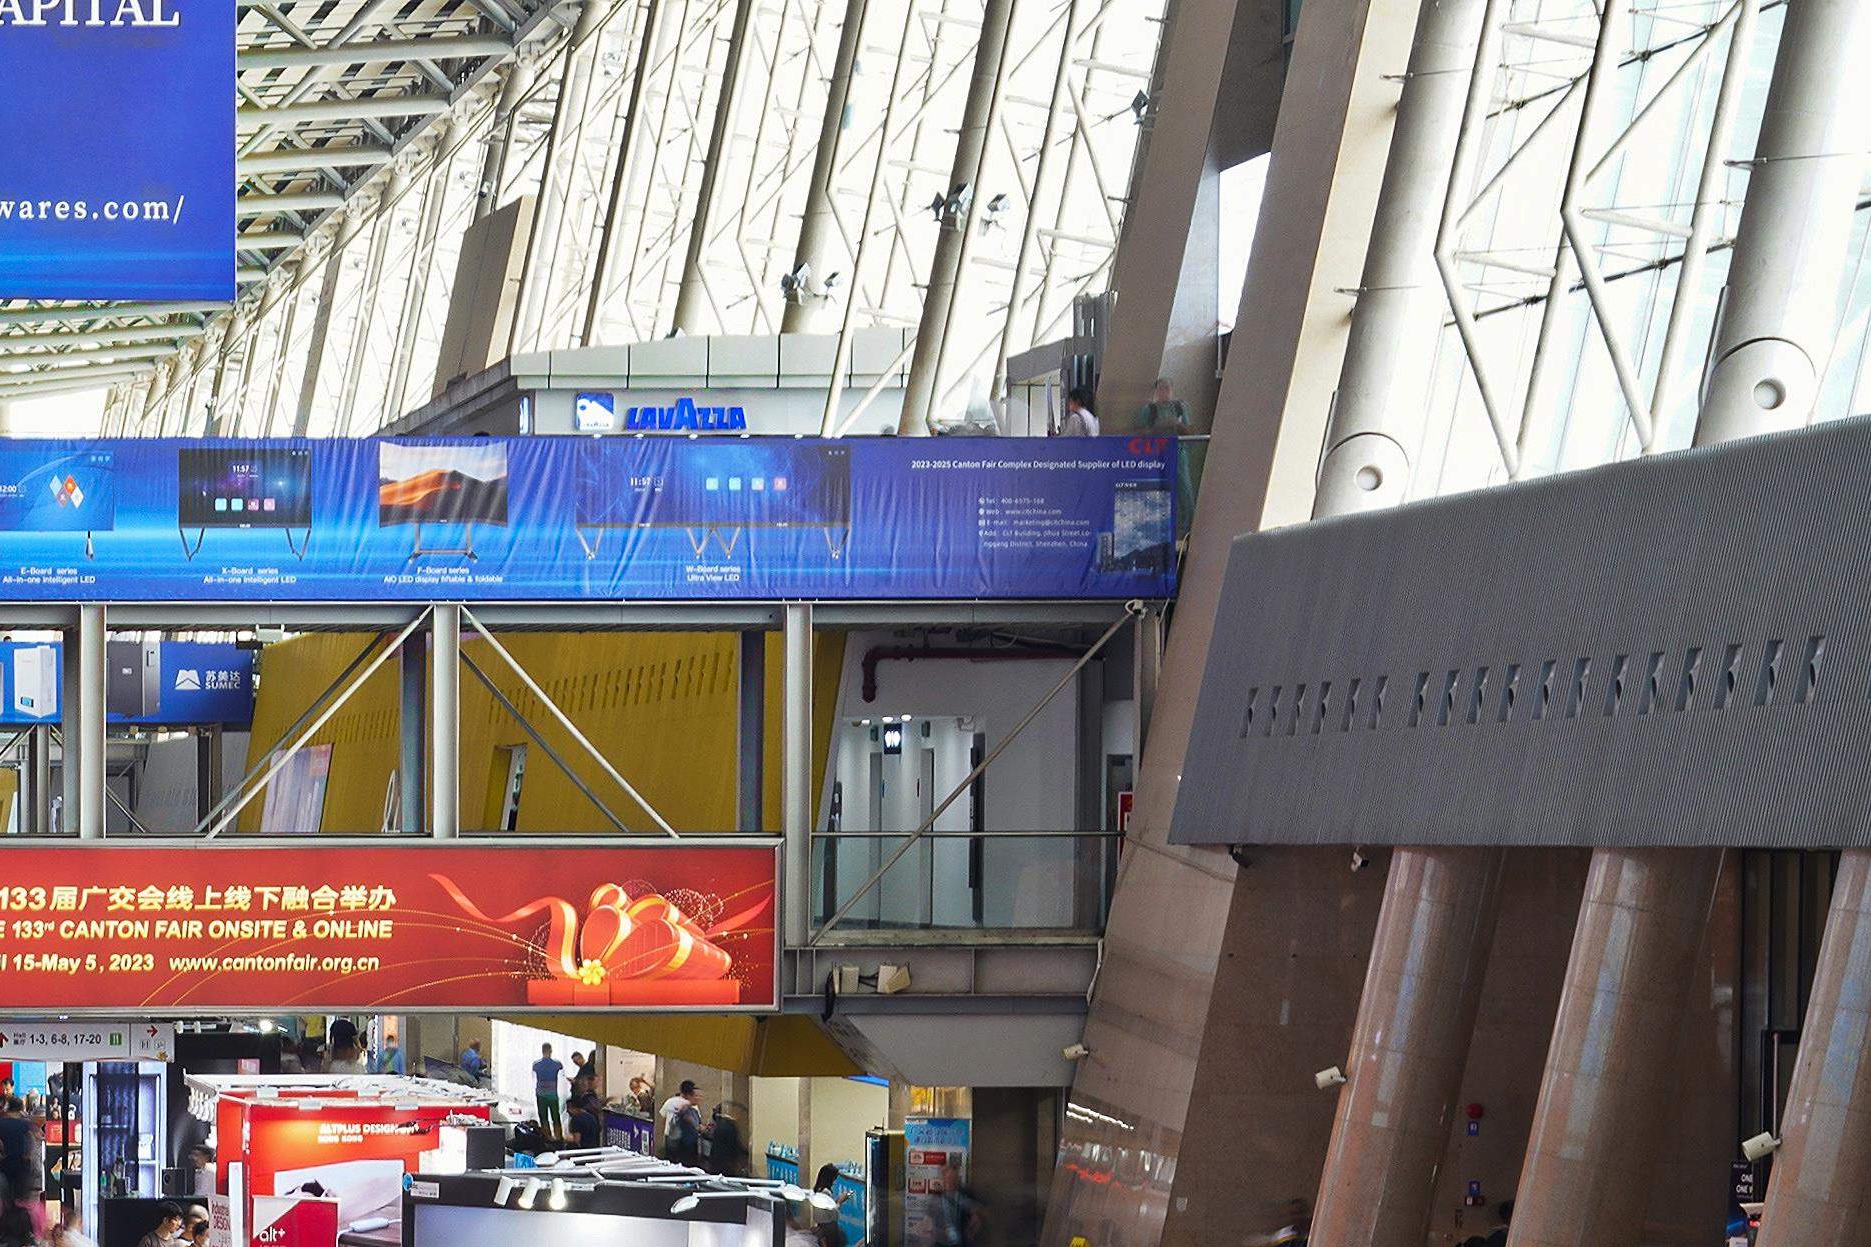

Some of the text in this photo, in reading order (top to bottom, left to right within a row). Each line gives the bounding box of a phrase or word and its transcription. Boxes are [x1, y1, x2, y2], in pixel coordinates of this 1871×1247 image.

[626, 397, 747, 430] LAVAZZA
[952, 459, 981, 469] Canton
[981, 459, 996, 469] Fair
[997, 459, 1032, 471] Complex
[1033, 459, 1076, 471] Designated
[1077, 459, 1110, 471] Supplier
[1110, 459, 1120, 469] of
[1120, 459, 1137, 469] LED
[1137, 459, 1166, 471] display
[205, 670, 241, 681] 苏美达
[205, 681, 241, 690] SUMEC
[59, 919, 150, 939] CANTON
[154, 919, 203, 939] FAIR
[208, 919, 288, 939] ONSITE
[291, 919, 308, 940] &
[313, 919, 394, 939] ONLINE
[12, 953, 81, 975] 15-May
[108, 953, 155, 972] 2023
[168, 952, 380, 977] www.cantonfair.org.cn
[73, 1033, 102, 1045] 17-20
